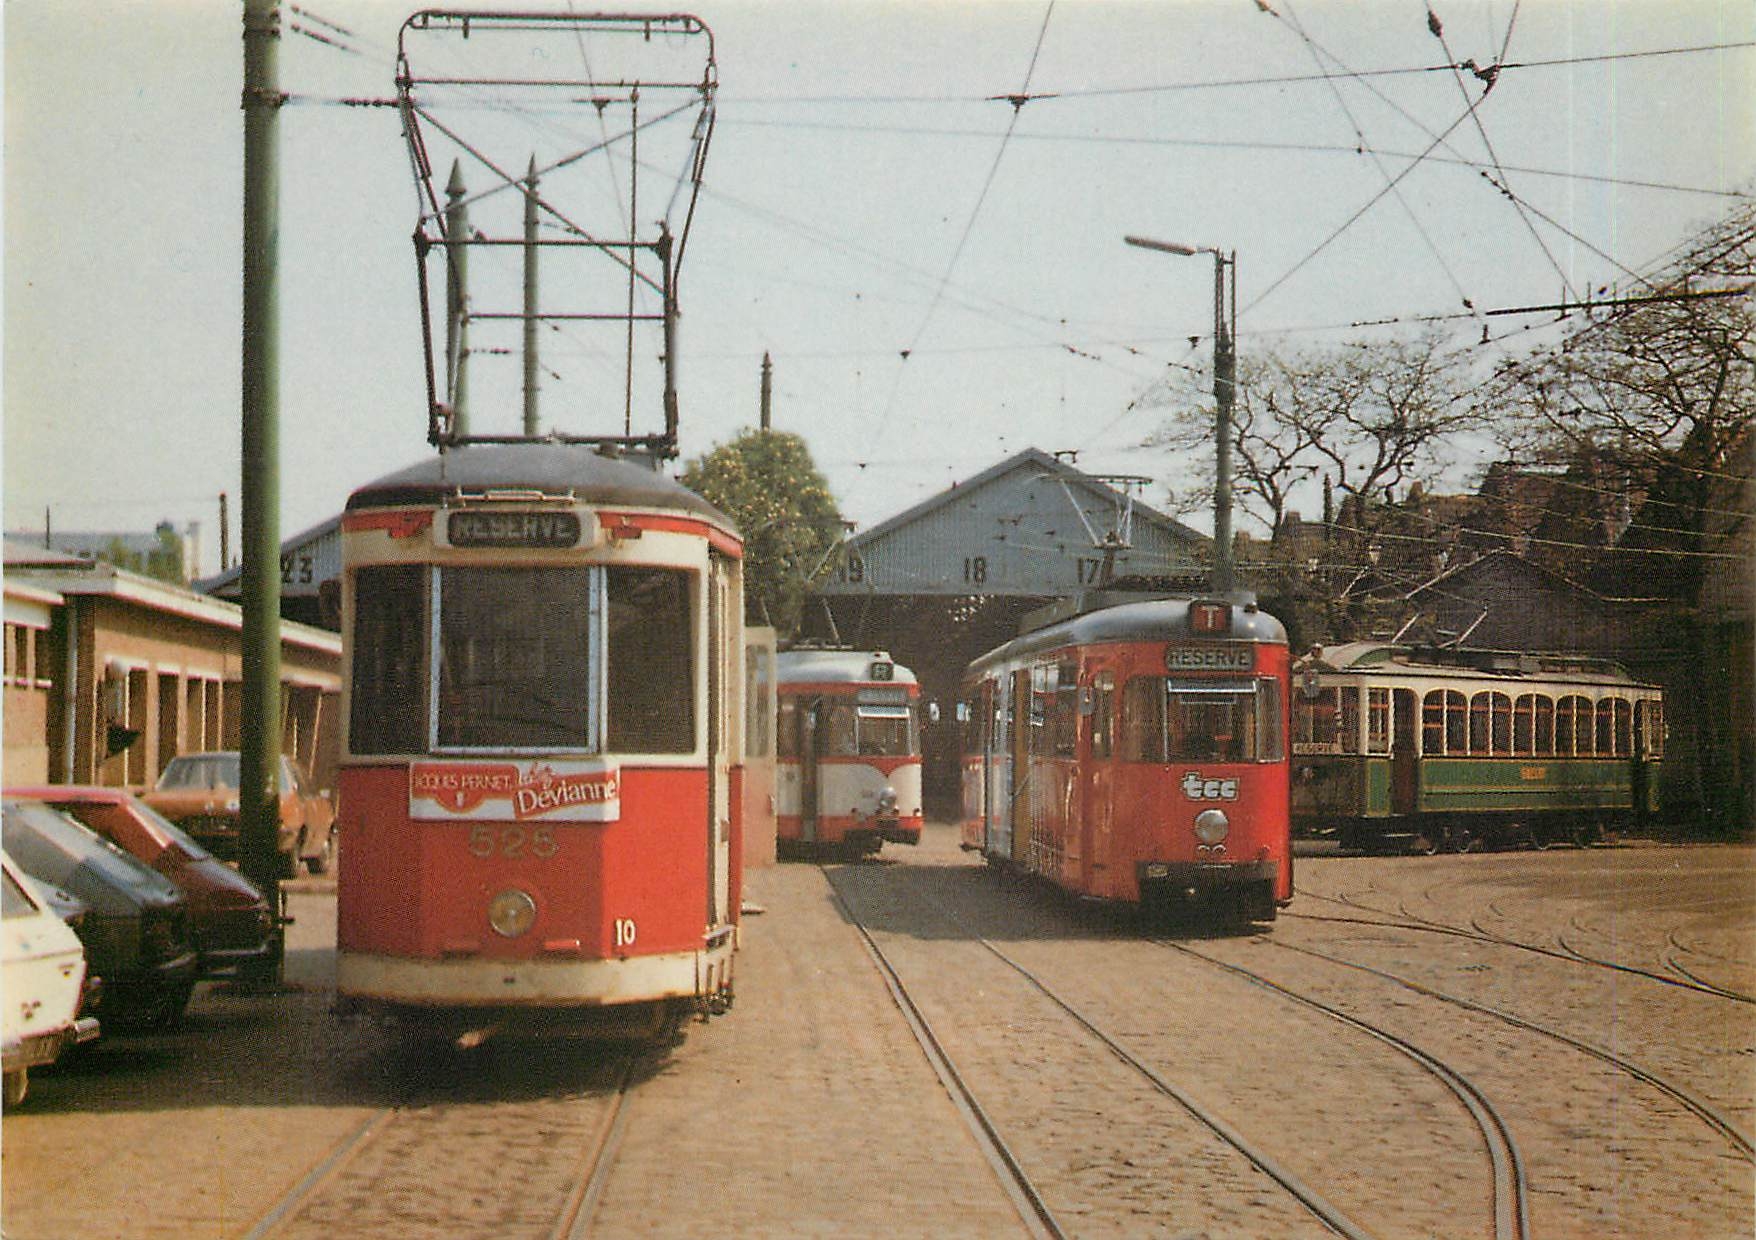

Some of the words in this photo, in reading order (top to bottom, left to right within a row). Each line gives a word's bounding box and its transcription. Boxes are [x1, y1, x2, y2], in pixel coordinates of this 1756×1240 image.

[454, 514, 573, 538] RESERVE
[964, 556, 986, 585] 18
[1077, 557, 1100, 584] 17
[1201, 605, 1220, 628] T
[1168, 647, 1250, 667] RESERVE
[1182, 772, 1239, 800] tcc
[615, 918, 636, 946] 10
